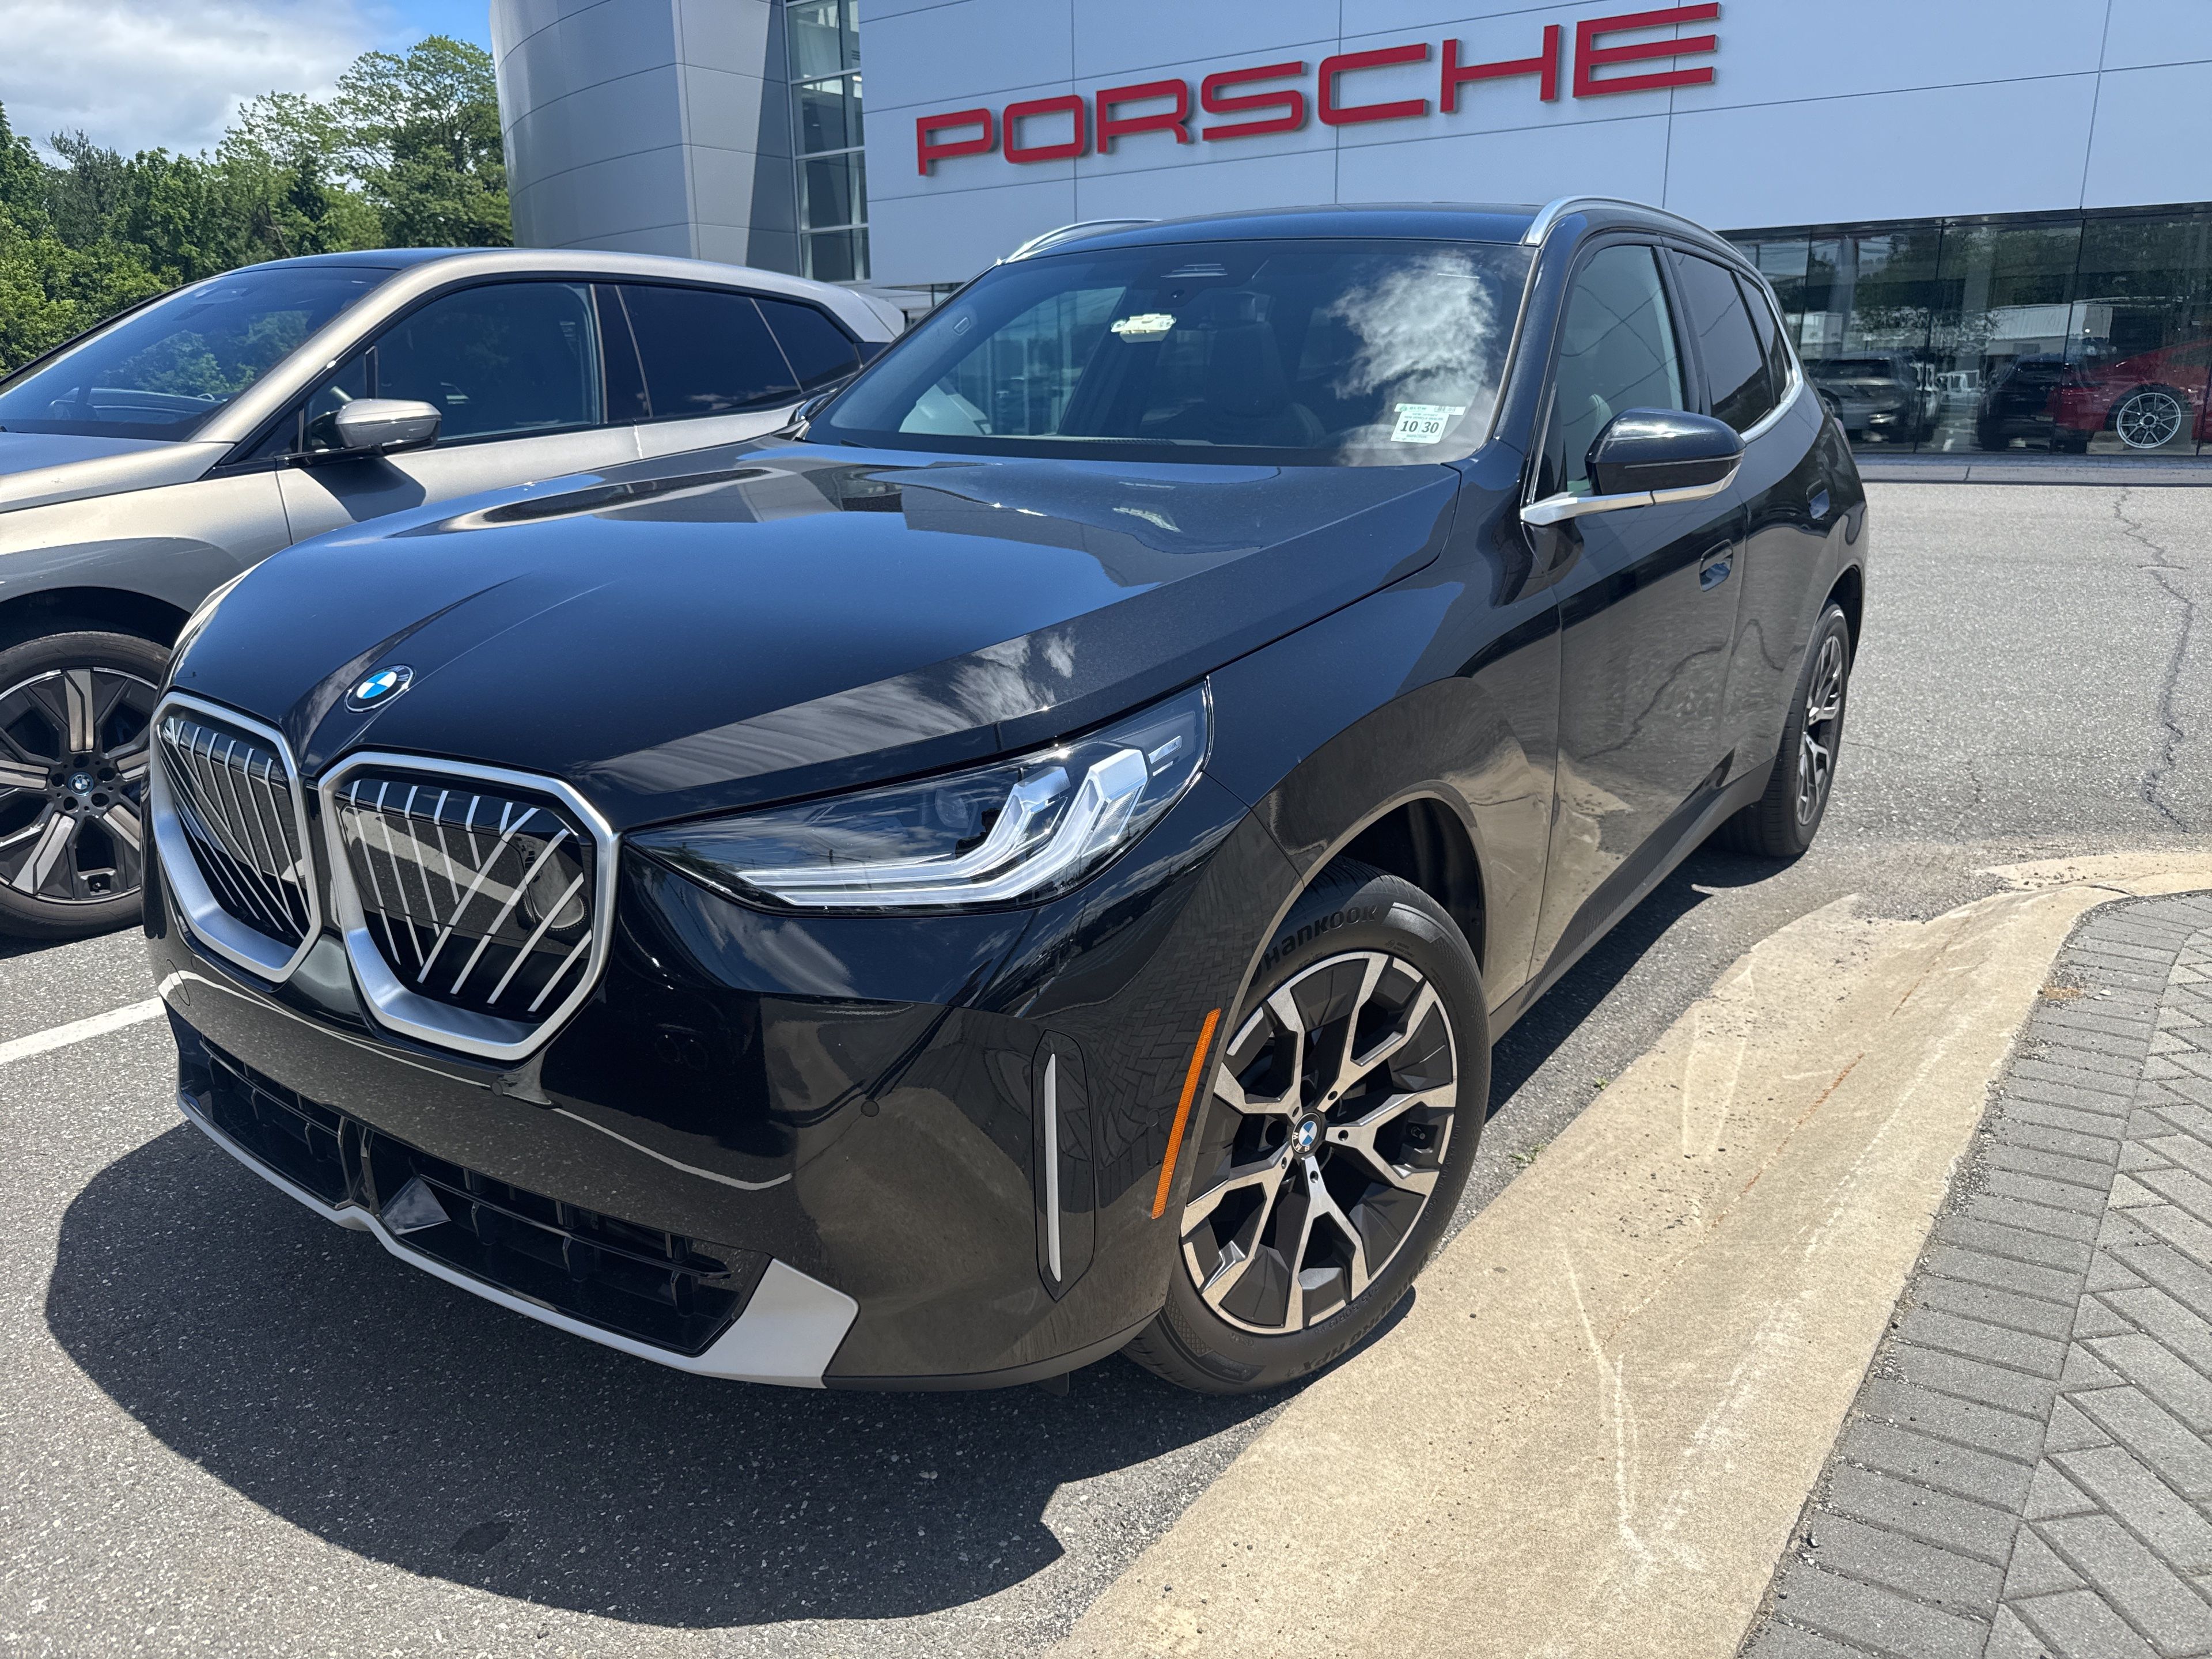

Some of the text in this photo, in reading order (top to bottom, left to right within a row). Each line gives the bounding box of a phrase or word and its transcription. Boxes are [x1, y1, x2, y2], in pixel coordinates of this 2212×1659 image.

[917, 2, 1721, 176] PORSCHE
[1400, 421, 1440, 433] 10 30
[1293, 1132, 1309, 1151] BMW
[1328, 1304, 1359, 1328] 50R19
